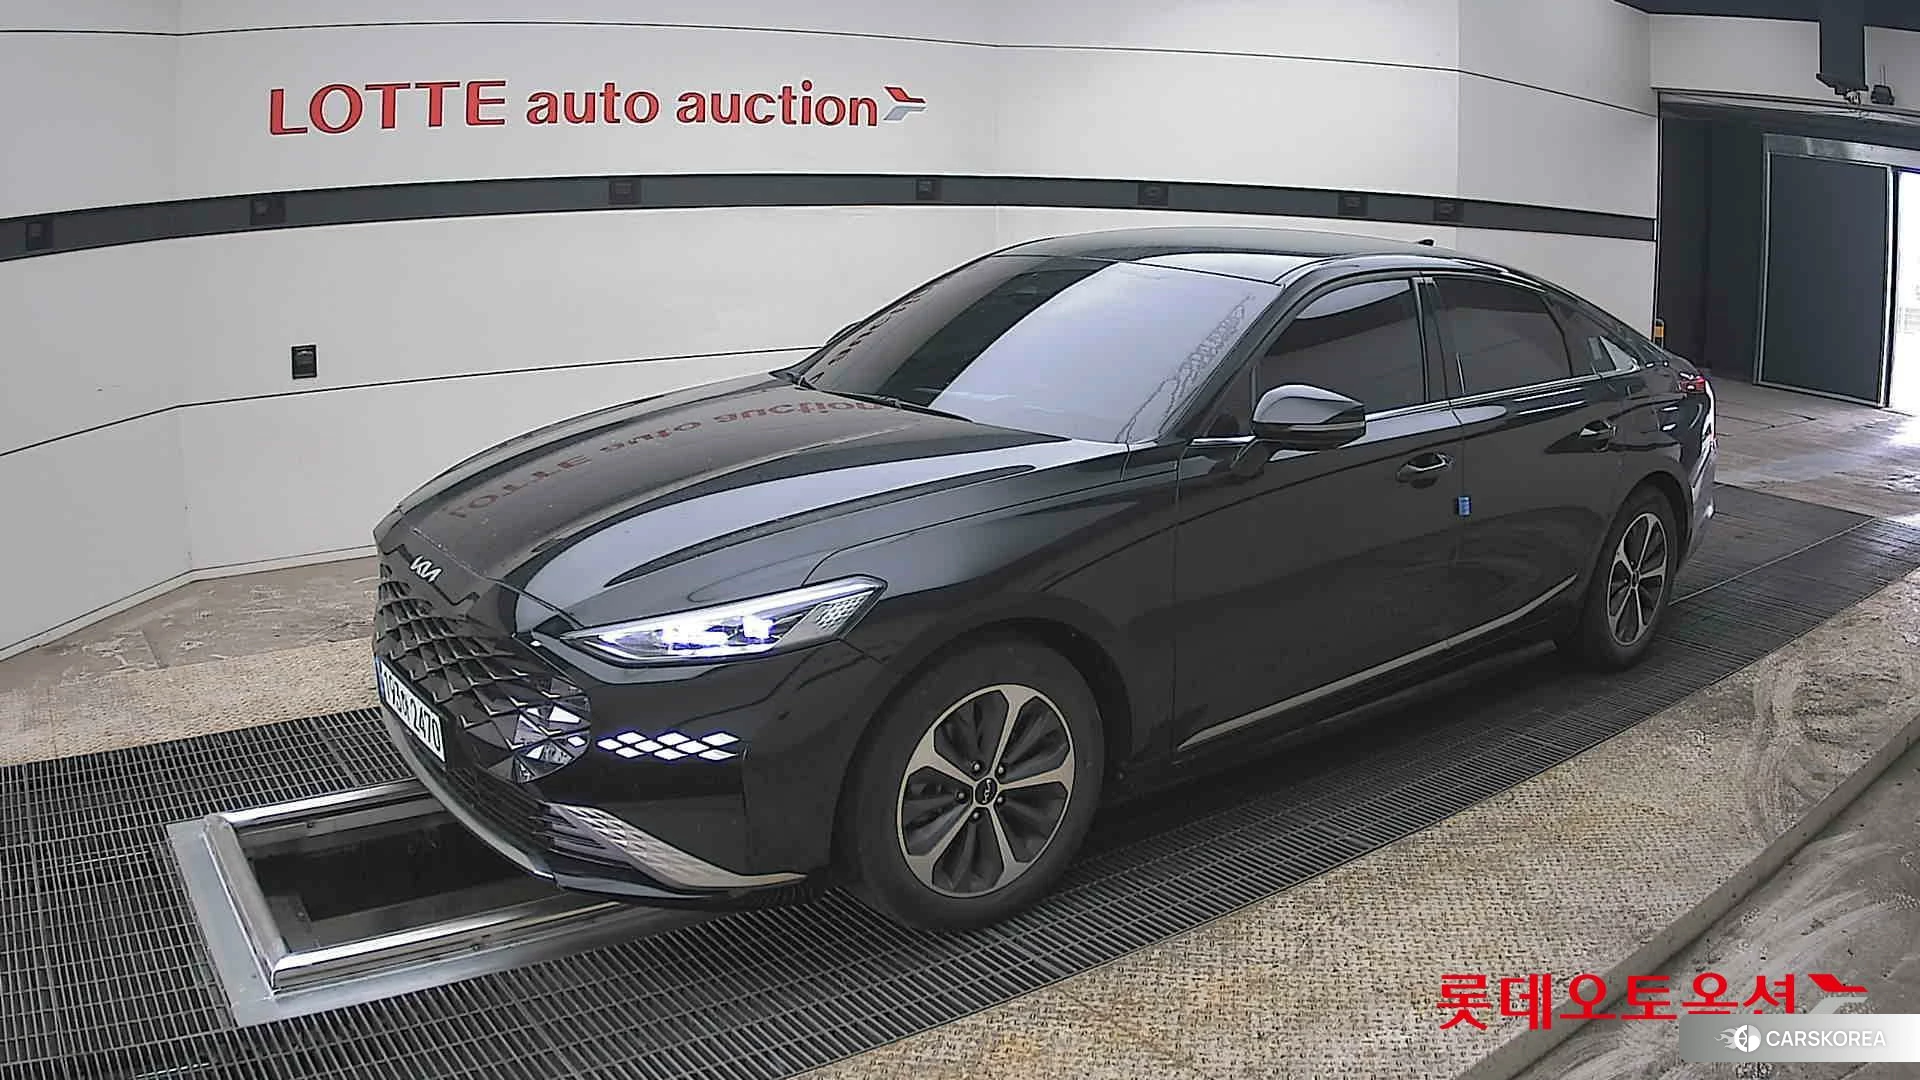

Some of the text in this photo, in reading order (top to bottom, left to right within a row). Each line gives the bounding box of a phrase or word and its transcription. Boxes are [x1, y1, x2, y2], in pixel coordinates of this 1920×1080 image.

[270, 80, 878, 136] LOTTE auto auction
[410, 555, 442, 583] KIA
[409, 697, 441, 752] 2470
